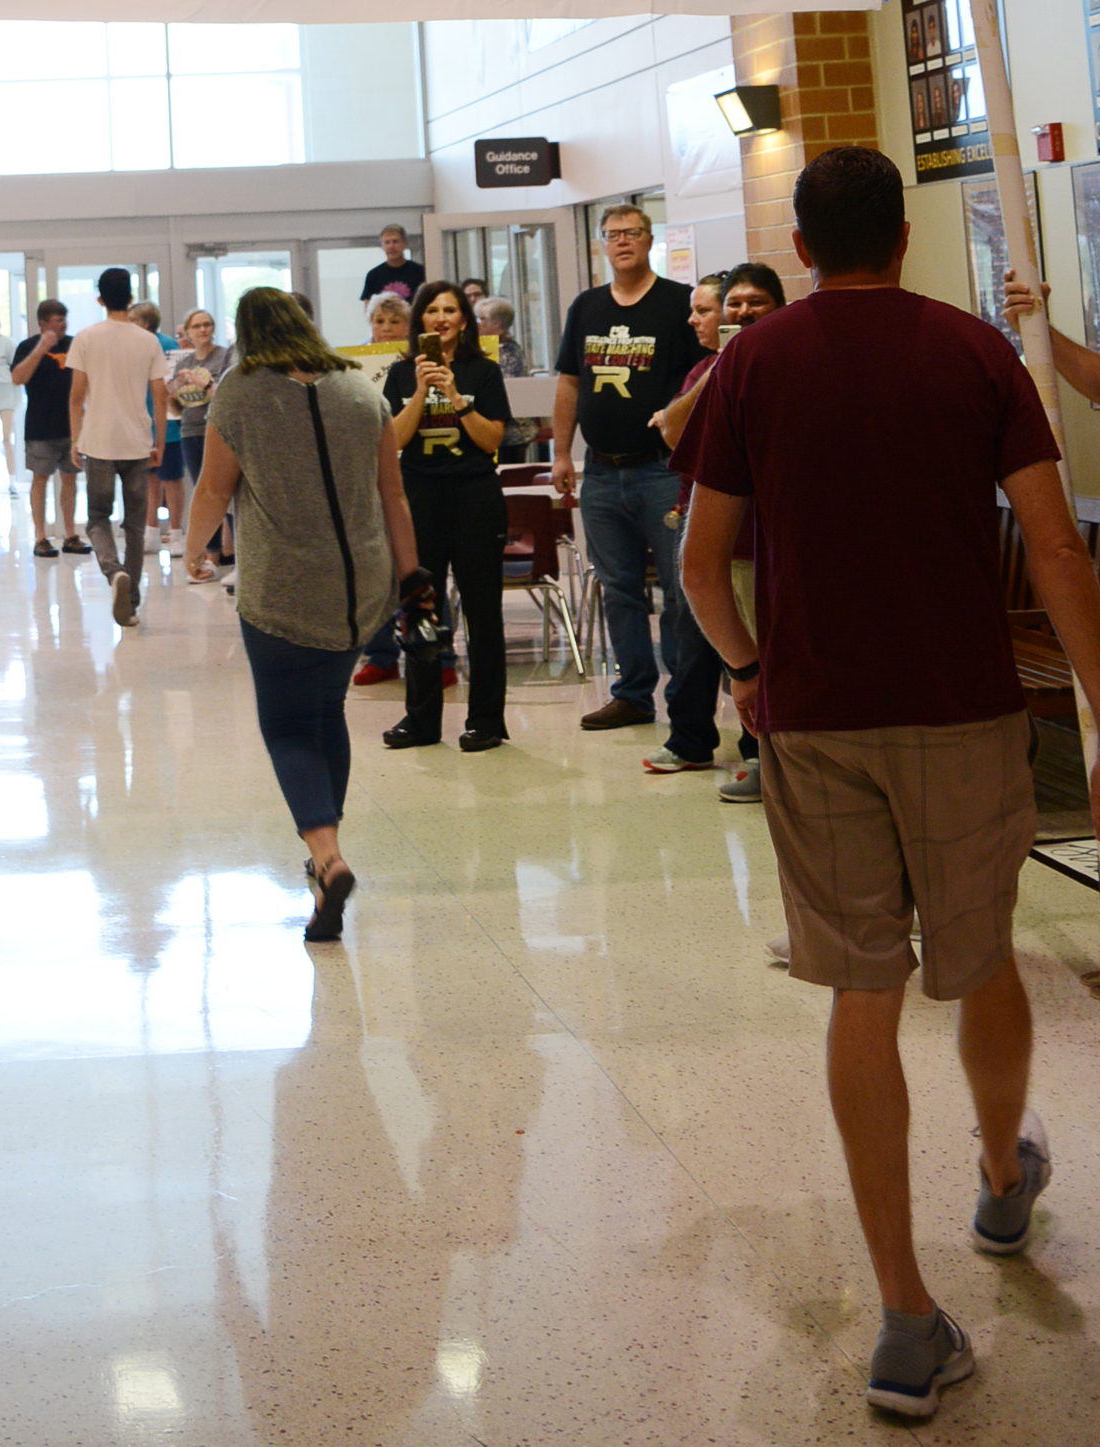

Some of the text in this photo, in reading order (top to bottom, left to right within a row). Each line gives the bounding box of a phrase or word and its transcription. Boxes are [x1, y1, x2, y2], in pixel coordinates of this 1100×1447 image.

[485, 151, 538, 162] Guidance
[917, 143, 994, 171] ESTABLISHING EXCELL
[495, 163, 531, 175] Office
